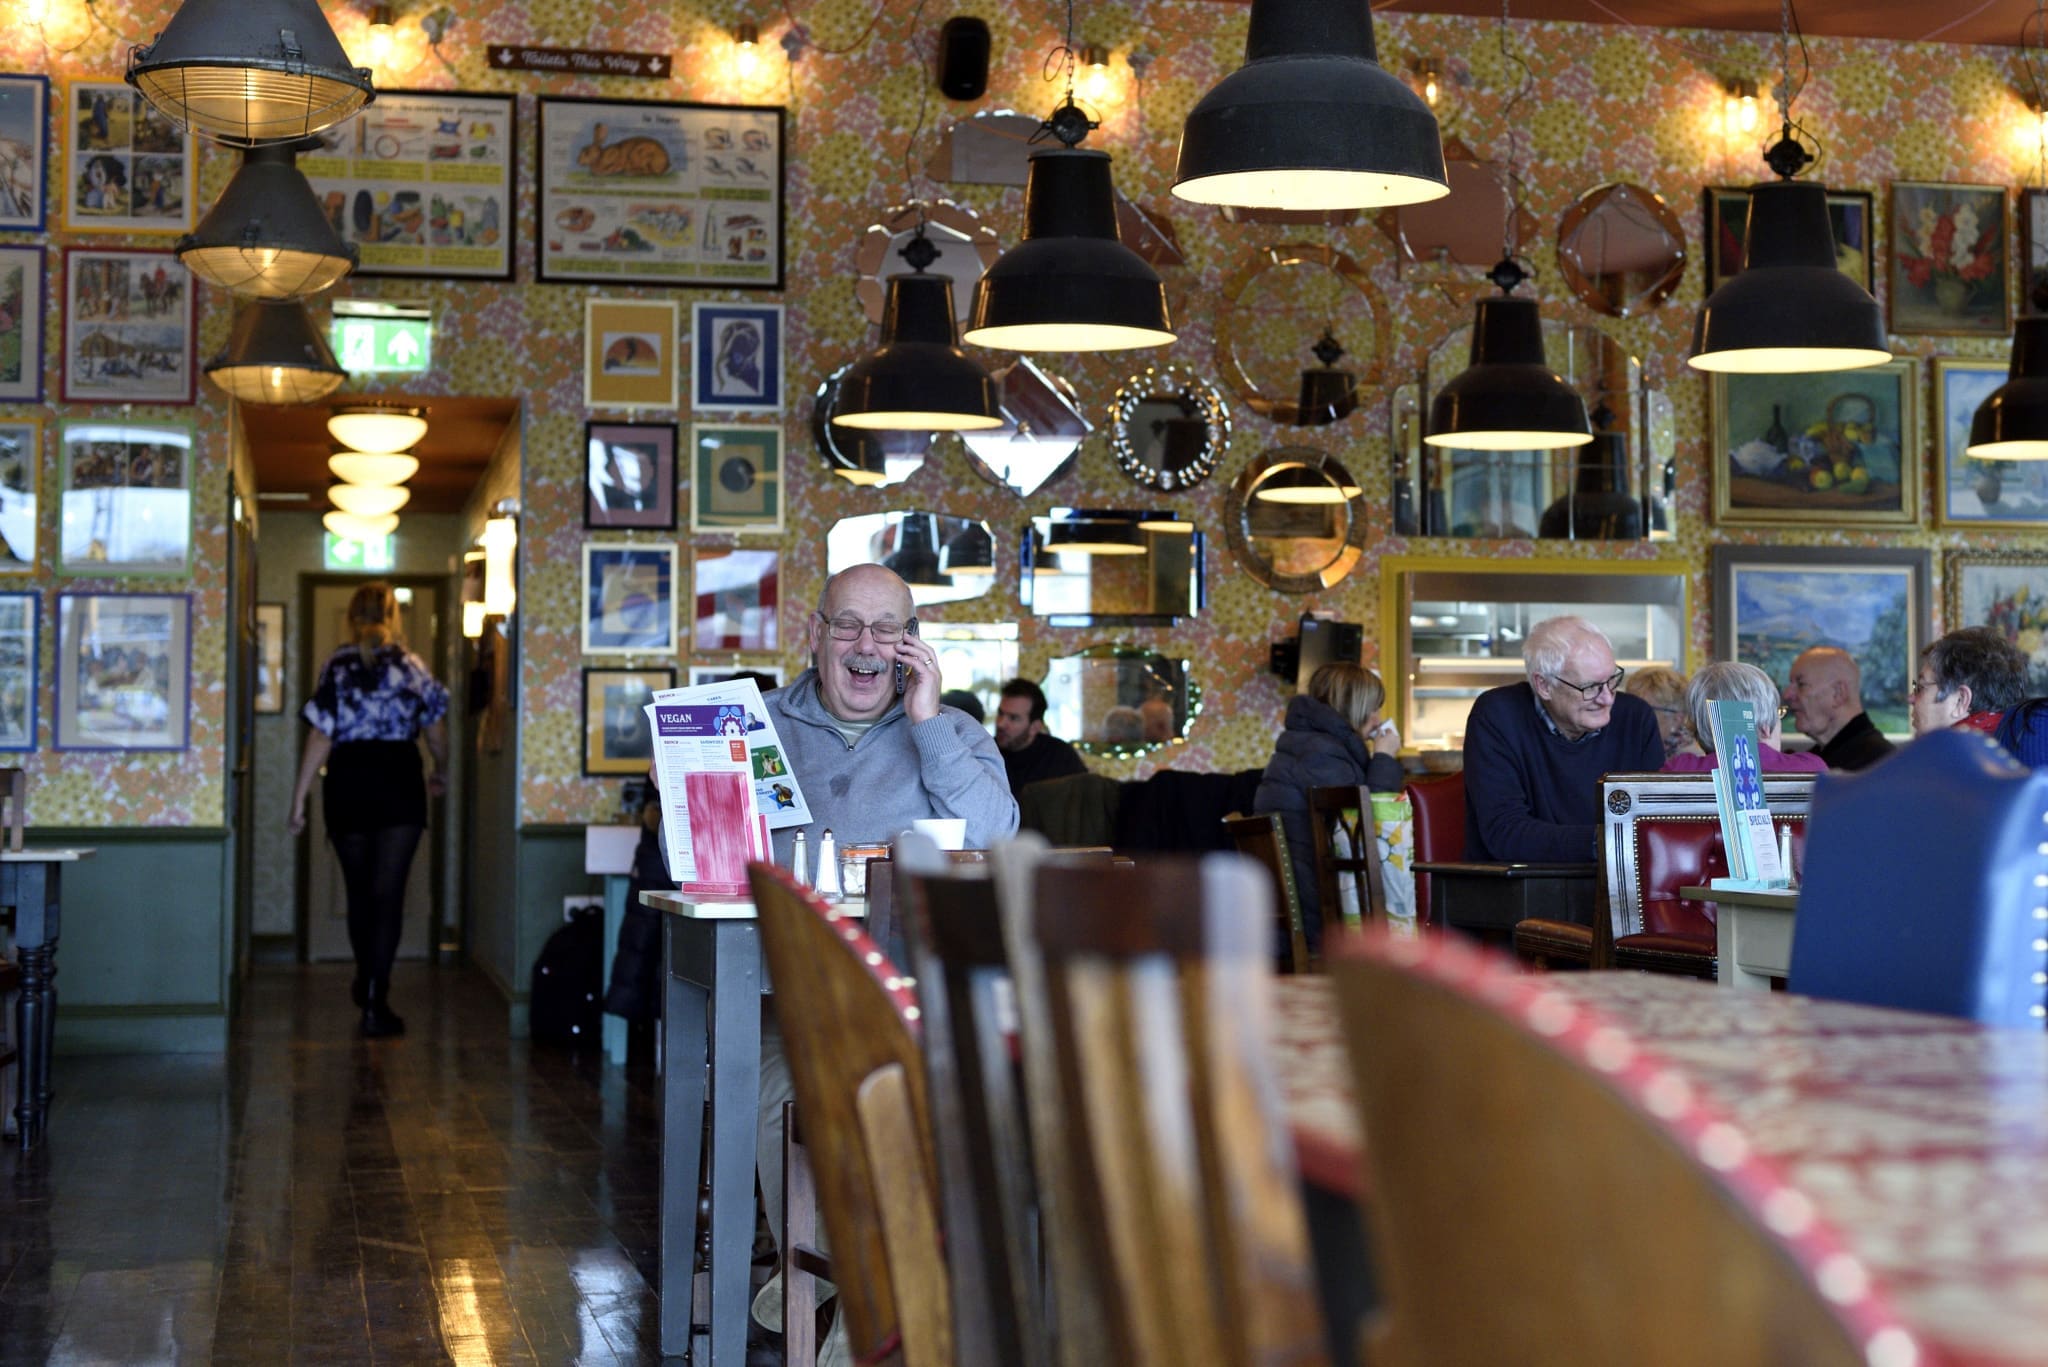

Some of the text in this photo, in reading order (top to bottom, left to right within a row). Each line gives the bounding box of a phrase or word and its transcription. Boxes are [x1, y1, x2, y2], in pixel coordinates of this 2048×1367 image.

[521, 50, 640, 73] Toilets This Way
[660, 713, 692, 723] VEGAN
[1749, 815, 1771, 826] SPECIALS
